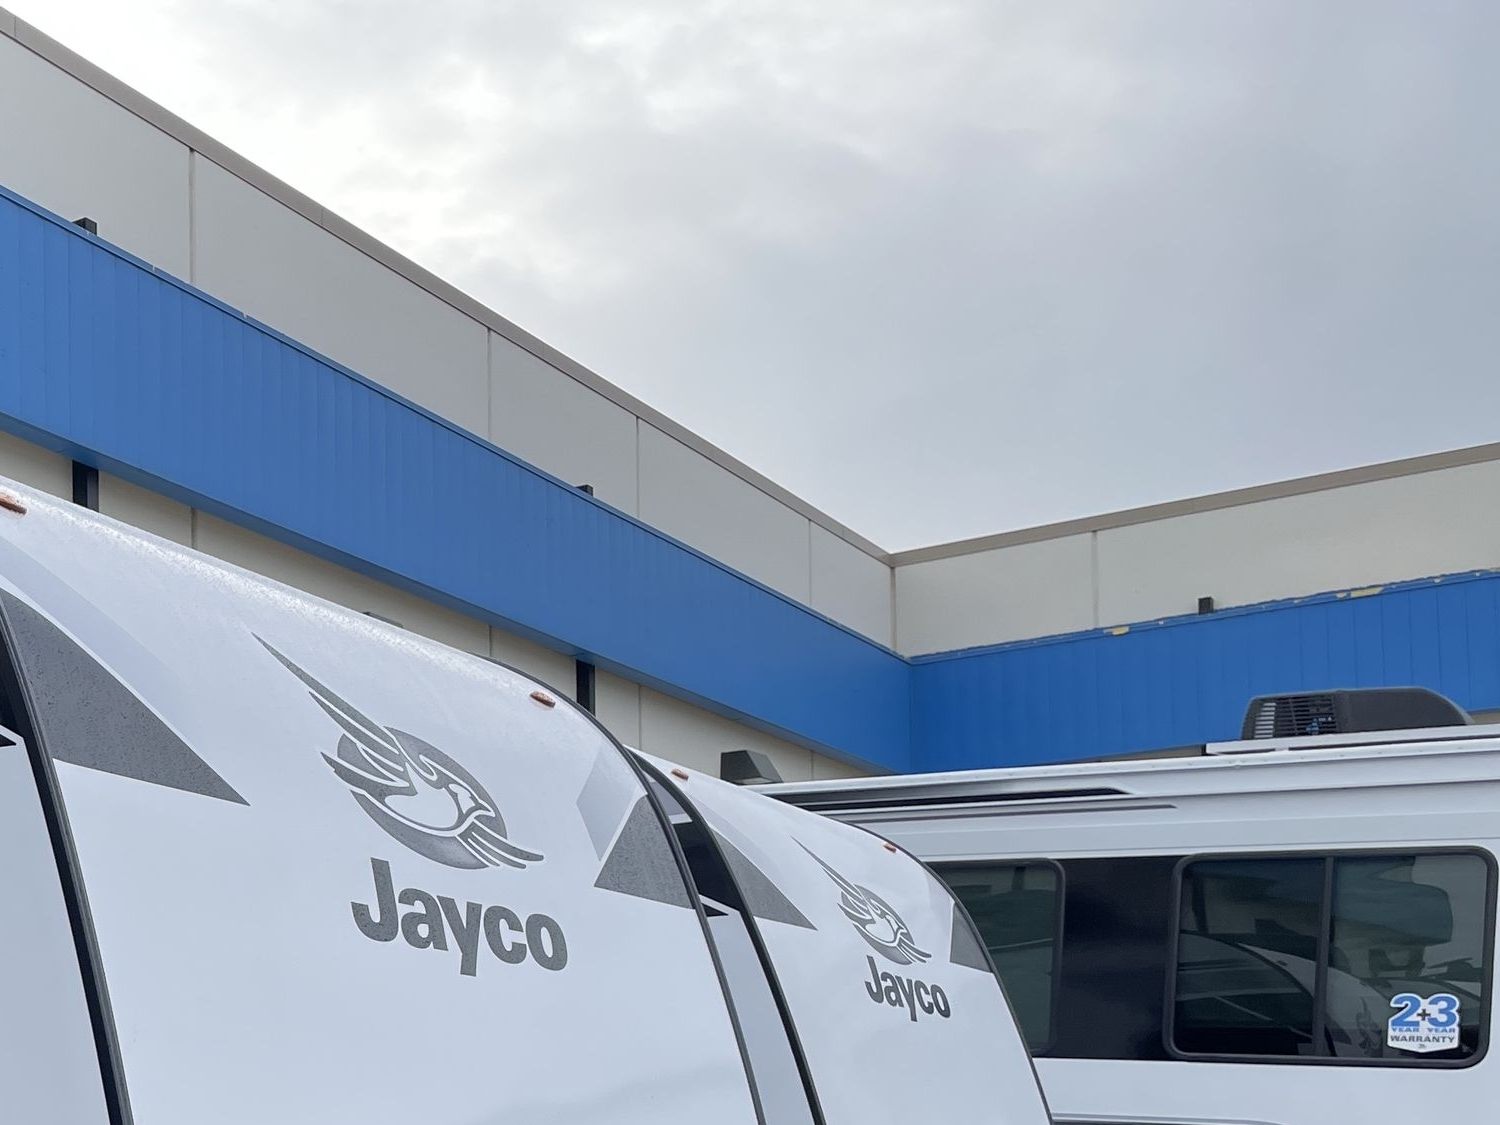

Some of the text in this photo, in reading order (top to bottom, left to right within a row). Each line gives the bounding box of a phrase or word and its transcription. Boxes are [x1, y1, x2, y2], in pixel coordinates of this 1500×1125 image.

[350, 857, 568, 977] Jayco
[864, 954, 951, 1022] Jayco
[1390, 1035, 1455, 1043] WARRANTY
